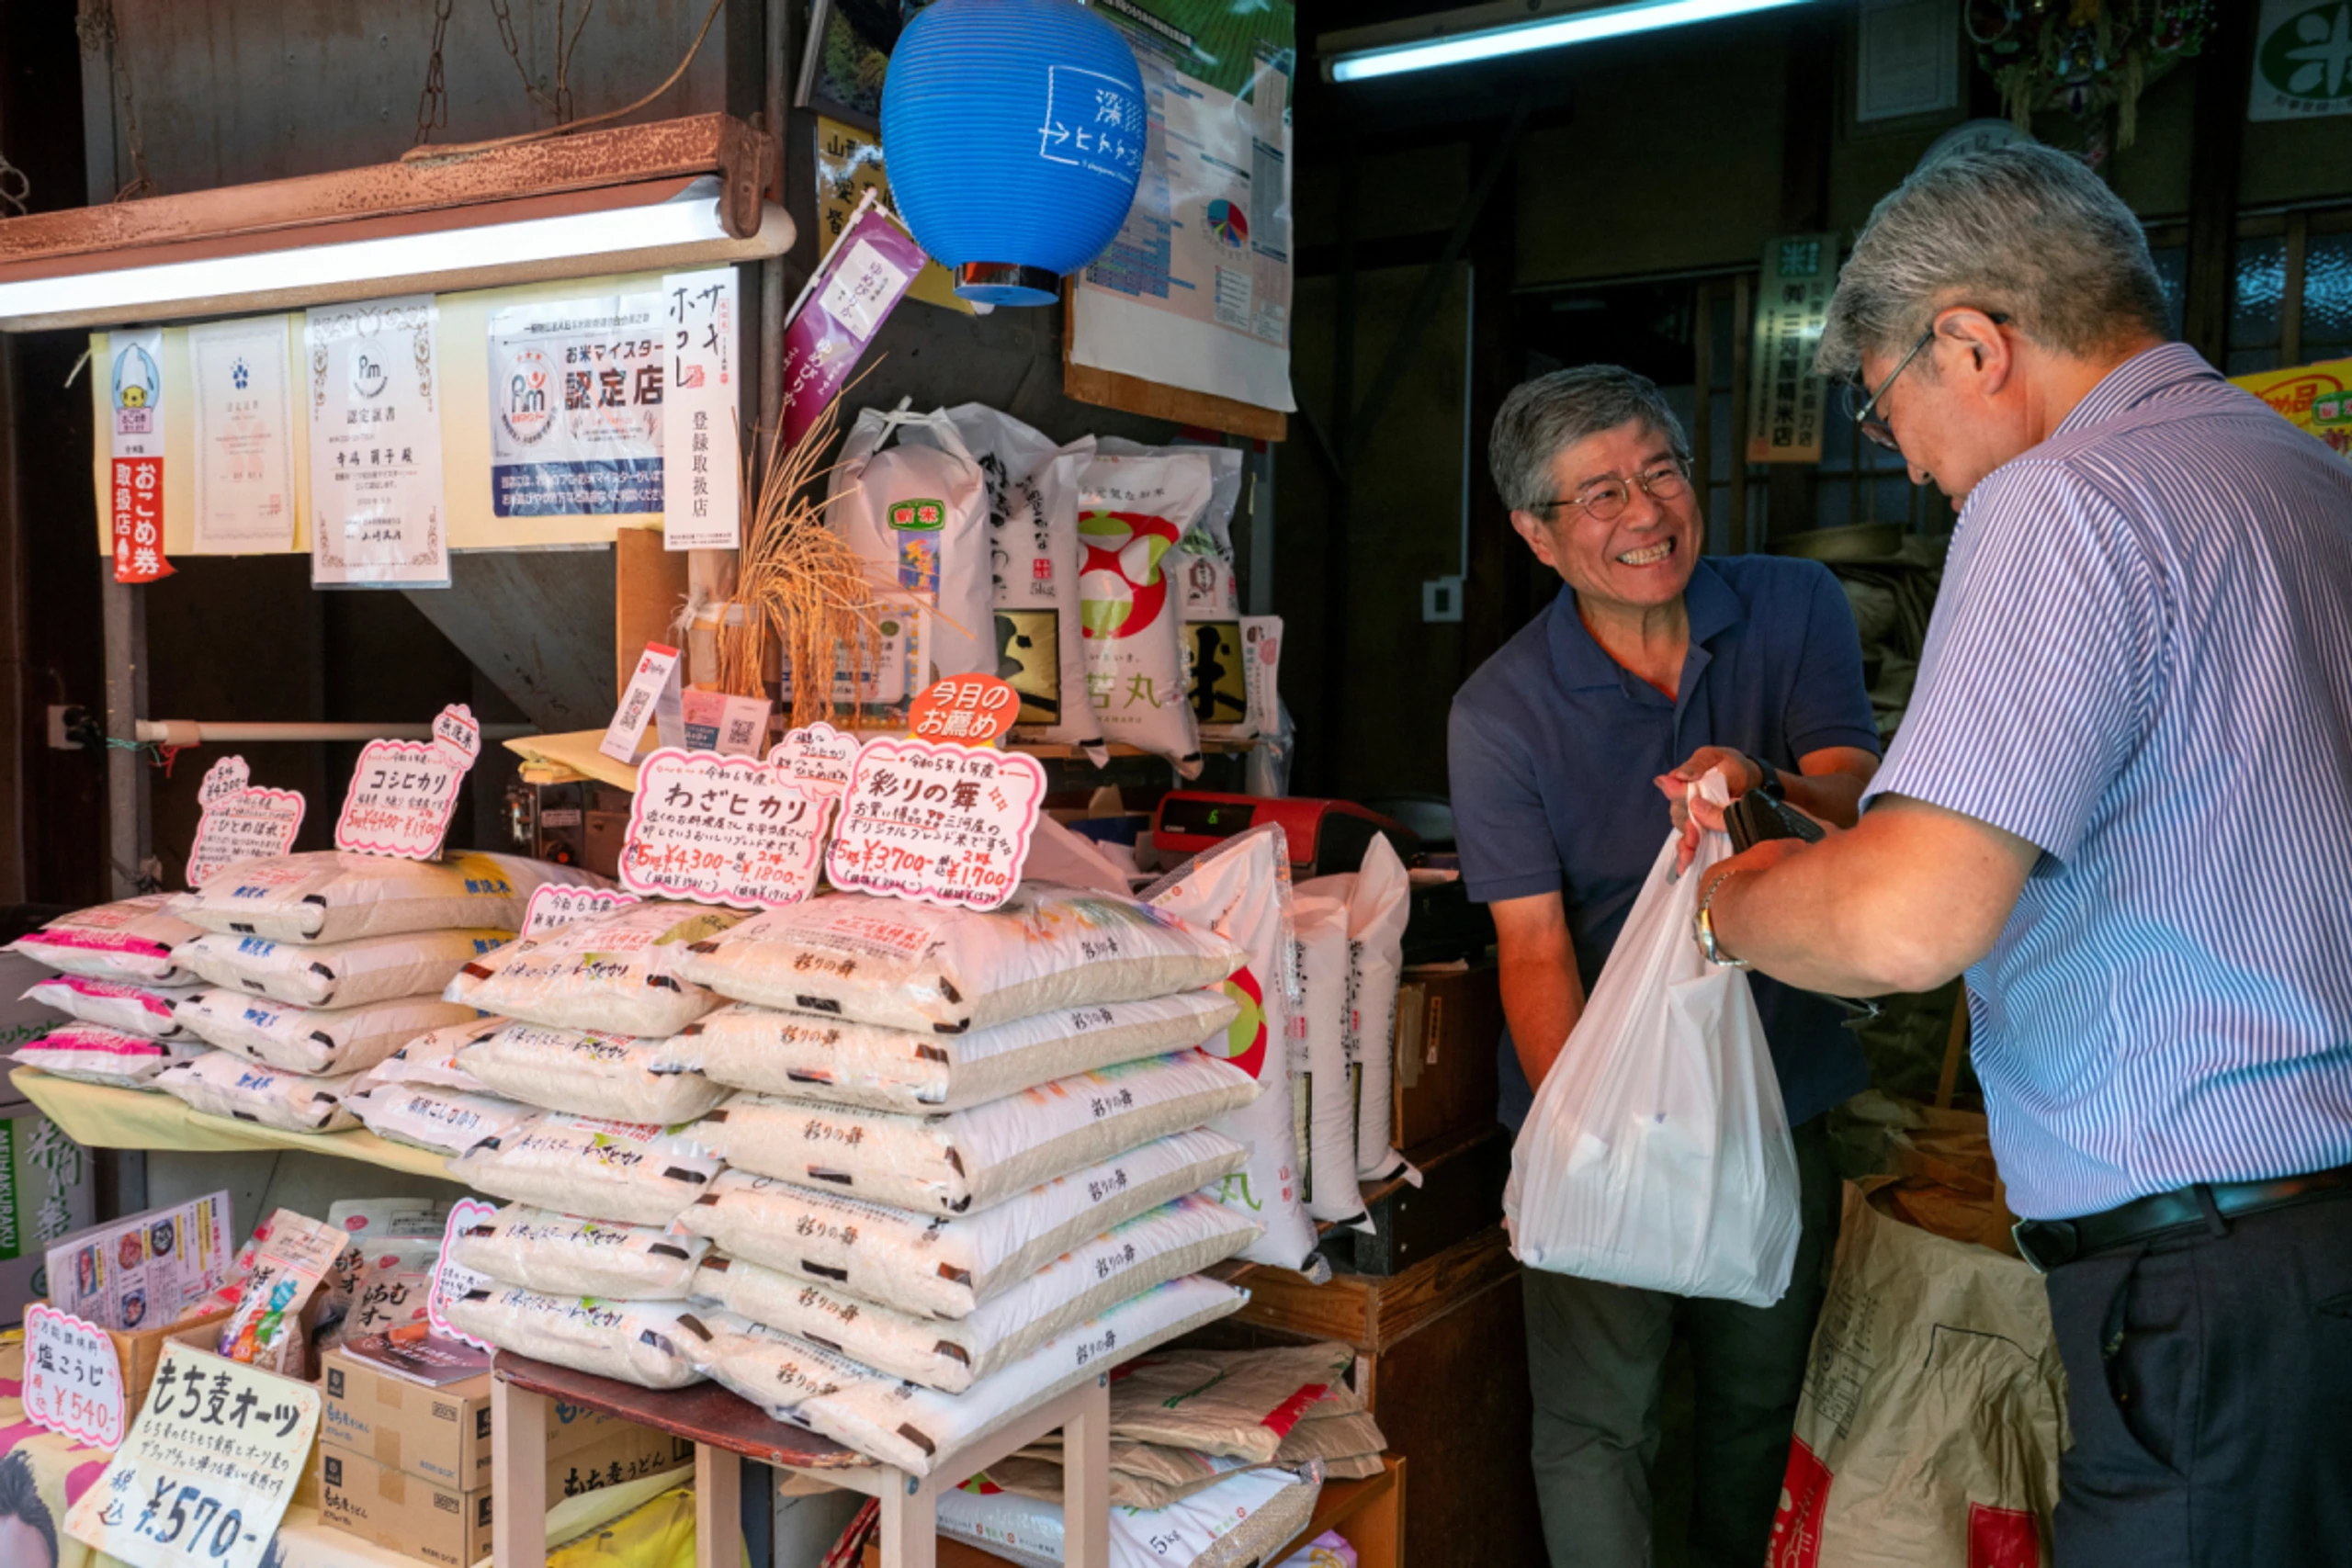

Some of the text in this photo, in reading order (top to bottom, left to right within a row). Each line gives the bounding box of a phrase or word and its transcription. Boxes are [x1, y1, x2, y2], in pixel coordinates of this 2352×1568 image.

[566, 339, 663, 364] お米マイスター
[565, 365, 663, 411] 認定店
[692, 411, 709, 517] 登録取扱店
[116, 462, 131, 536] 取扱店
[895, 506, 940, 524] 新米
[134, 462, 160, 575] おこめ券
[932, 682, 1010, 710] 今月の
[917, 709, 998, 739] お薦め
[369, 770, 447, 795] コシヒカリ
[869, 768, 981, 813] 彩りの舞
[664, 782, 807, 825] わざヒカリ
[238, 936, 276, 957] 無洗米
[794, 951, 857, 979] 彩りの舞
[780, 1022, 842, 1046] 彩りの舞
[803, 1119, 865, 1149] 彩りの舞
[796, 1213, 859, 1245] 彩りの舞
[797, 1285, 862, 1324] 彩りの舞
[38, 1342, 104, 1387] 塩こうじ
[153, 1358, 300, 1438] もち麦オーツ
[564, 1450, 665, 1497] もち麦うどん
